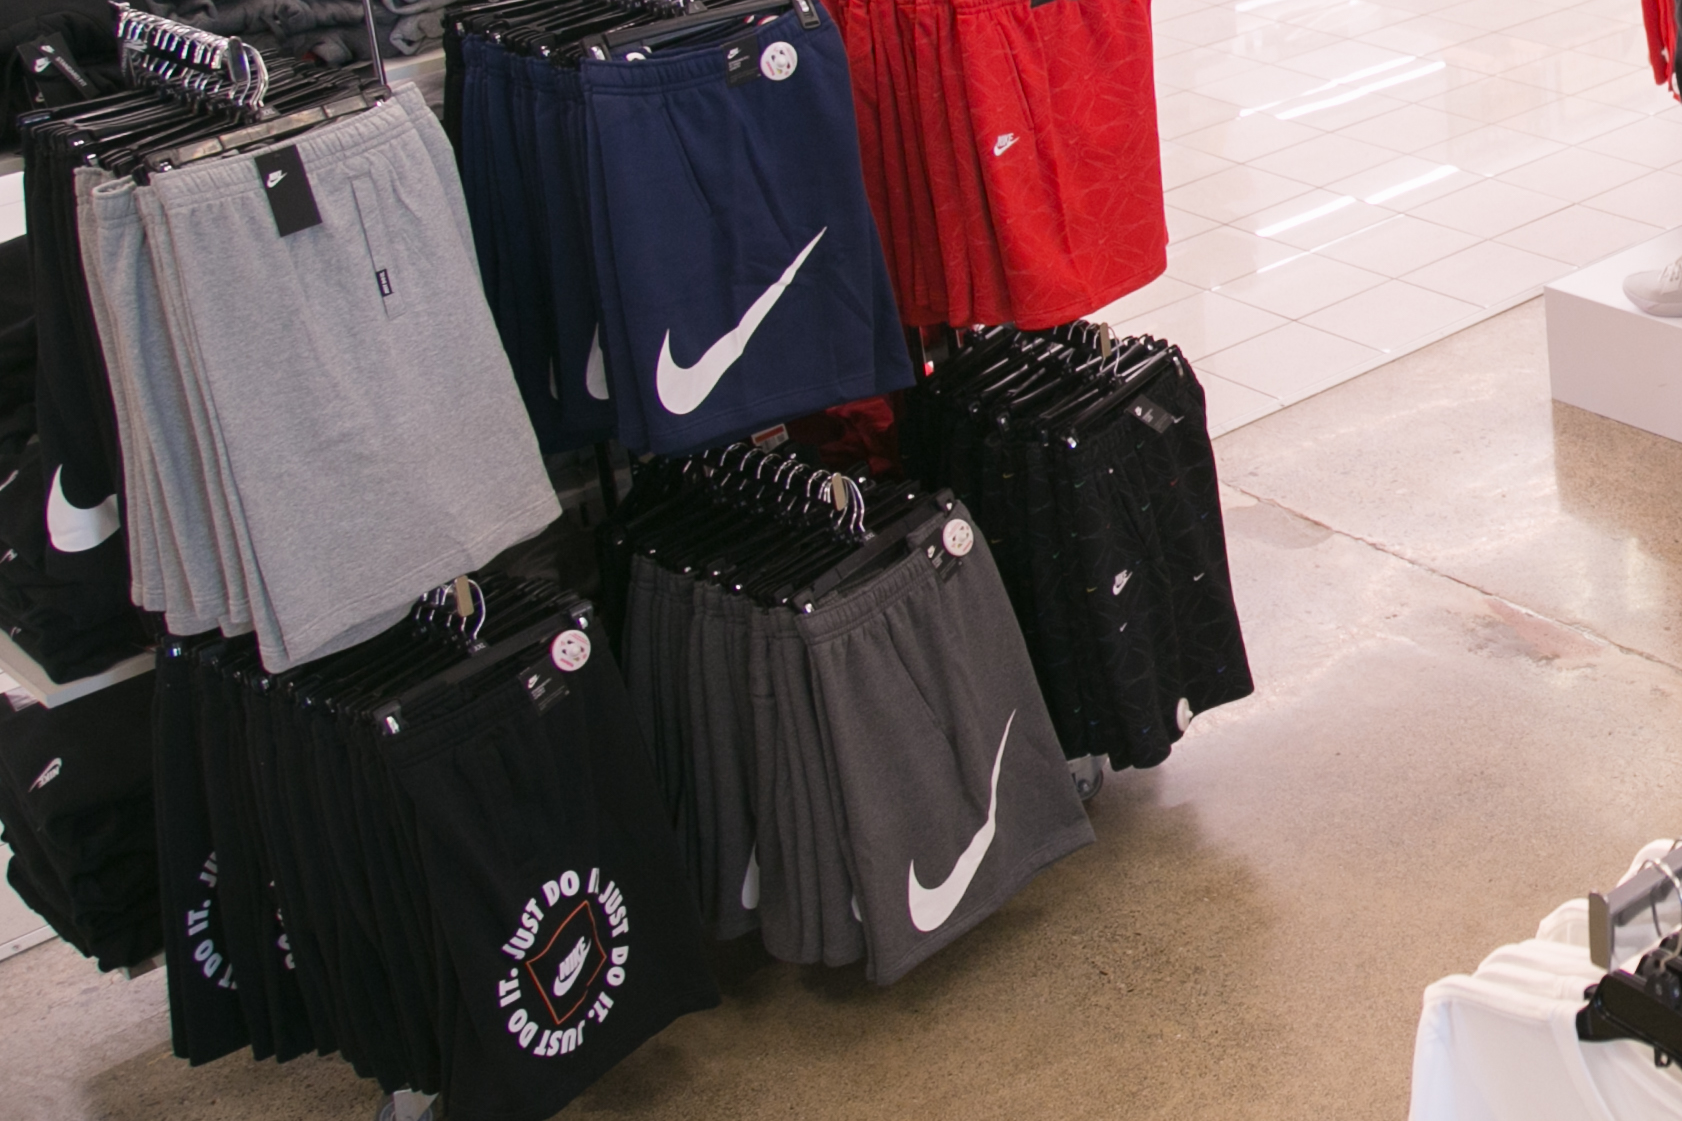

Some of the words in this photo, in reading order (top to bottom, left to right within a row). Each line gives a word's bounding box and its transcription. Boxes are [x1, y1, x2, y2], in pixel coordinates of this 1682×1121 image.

[502, 897, 545, 961] JUST
[541, 869, 580, 907] DO
[597, 880, 630, 938] JUST
[194, 938, 223, 979] DO
[605, 945, 630, 987] DO
[507, 1008, 539, 1049] DO
[532, 1019, 586, 1057] JUST
